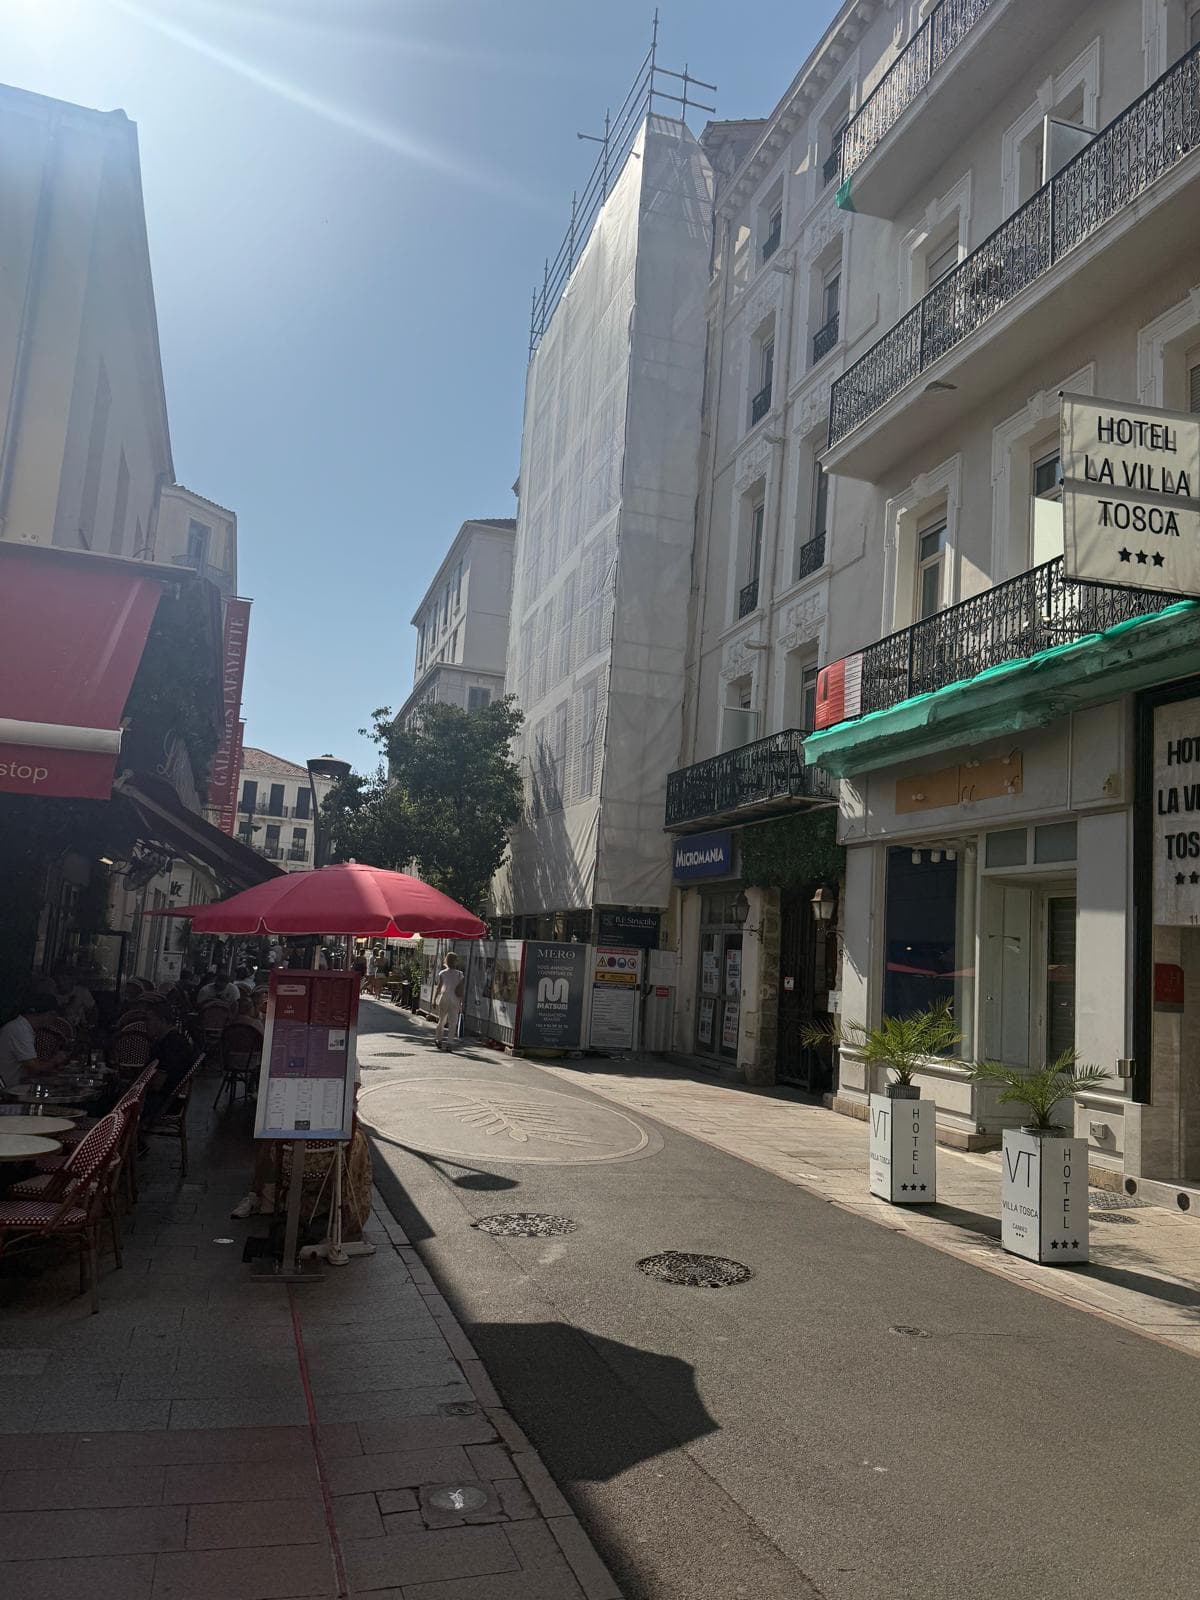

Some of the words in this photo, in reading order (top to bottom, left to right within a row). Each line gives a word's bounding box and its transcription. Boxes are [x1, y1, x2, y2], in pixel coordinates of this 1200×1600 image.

[1097, 415, 1177, 452] HOTEL
[1084, 454, 1115, 485] LA
[1122, 460, 1191, 497] VILLA
[1097, 500, 1180, 537] TOSCA
[1158, 787, 1179, 815] LA
[536, 948, 576, 960] MERO
[911, 1108, 921, 1175] HOTEL
[1062, 1148, 1072, 1229] HOTEL
[1002, 1199, 1018, 1213] VILLA
[1019, 1204, 1039, 1220] TOSCA
